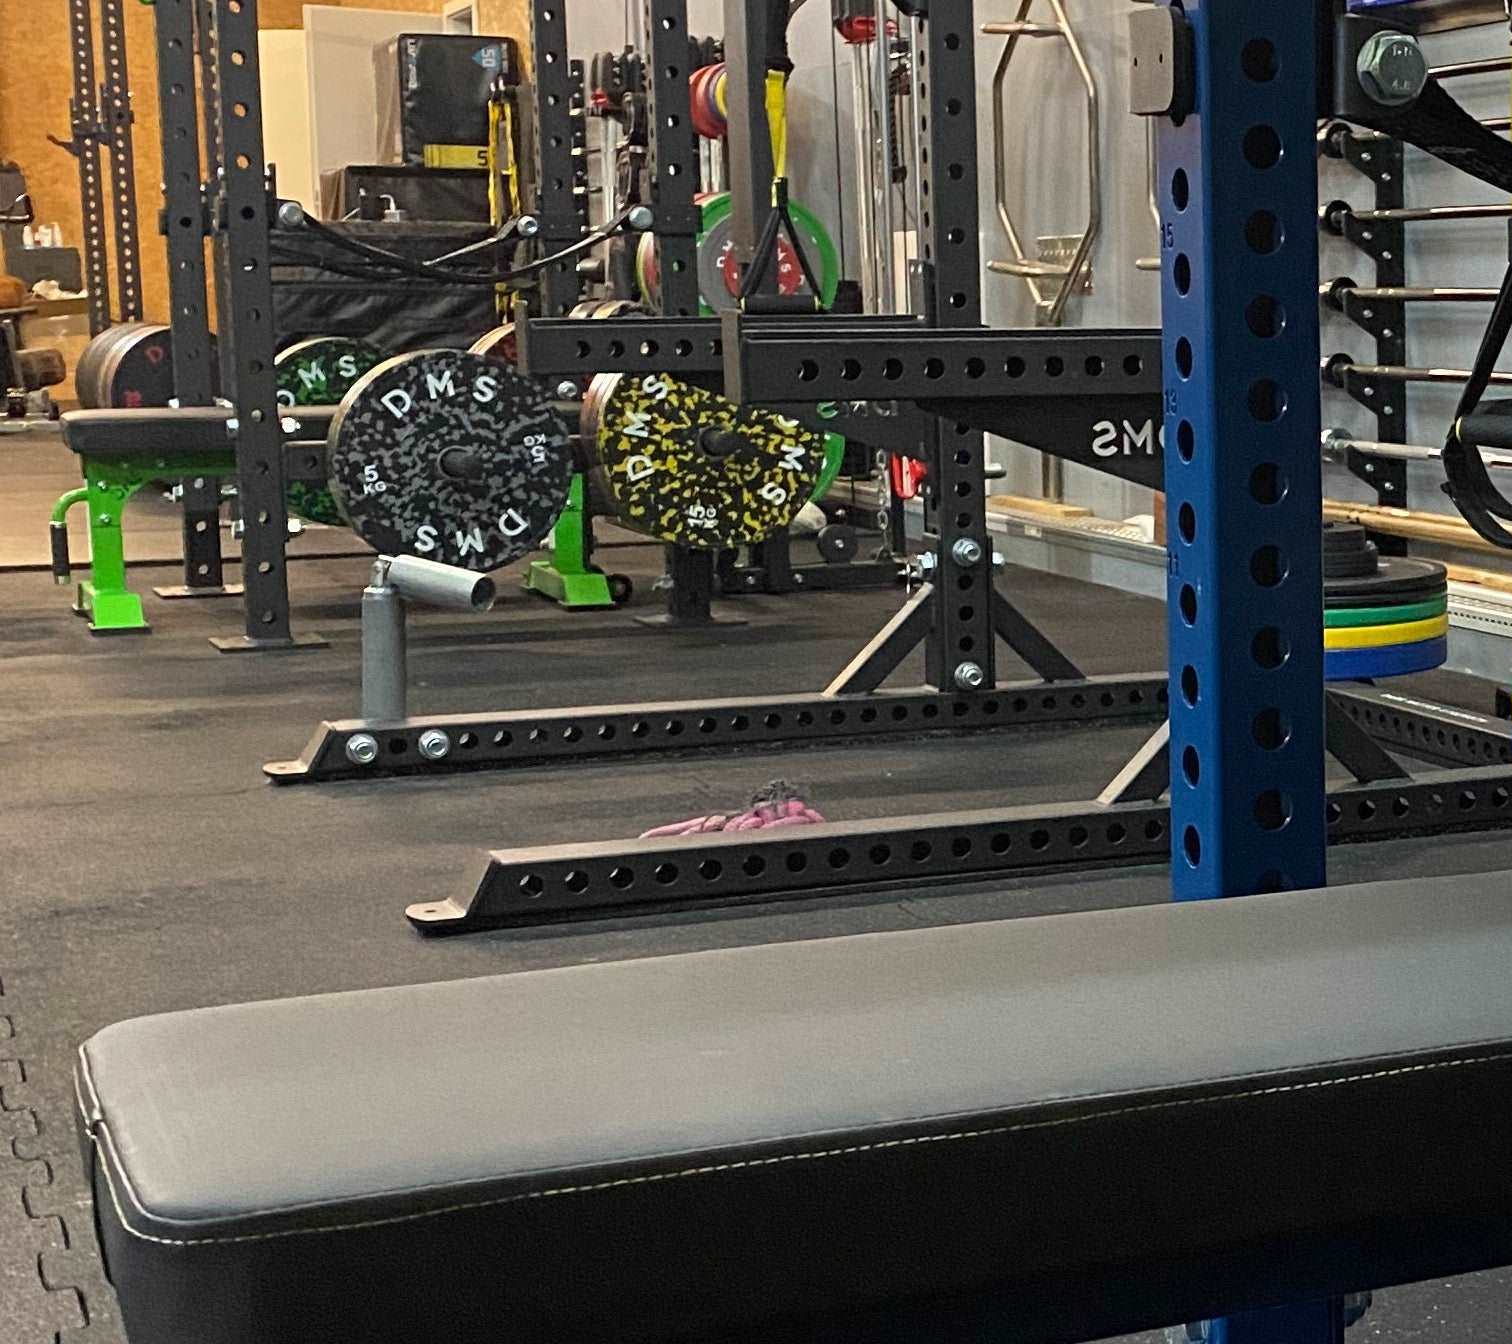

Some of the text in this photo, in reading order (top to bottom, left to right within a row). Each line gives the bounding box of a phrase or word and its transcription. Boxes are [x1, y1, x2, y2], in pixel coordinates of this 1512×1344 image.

[481, 47, 497, 68] 50
[1160, 222, 1175, 249] 15
[380, 370, 498, 419] DMS
[622, 375, 668, 482] DMS
[530, 446, 545, 463] 5
[364, 465, 379, 483] 5
[363, 482, 387, 495] KG
[688, 505, 705, 529] 15
[413, 508, 529, 557] DMS
